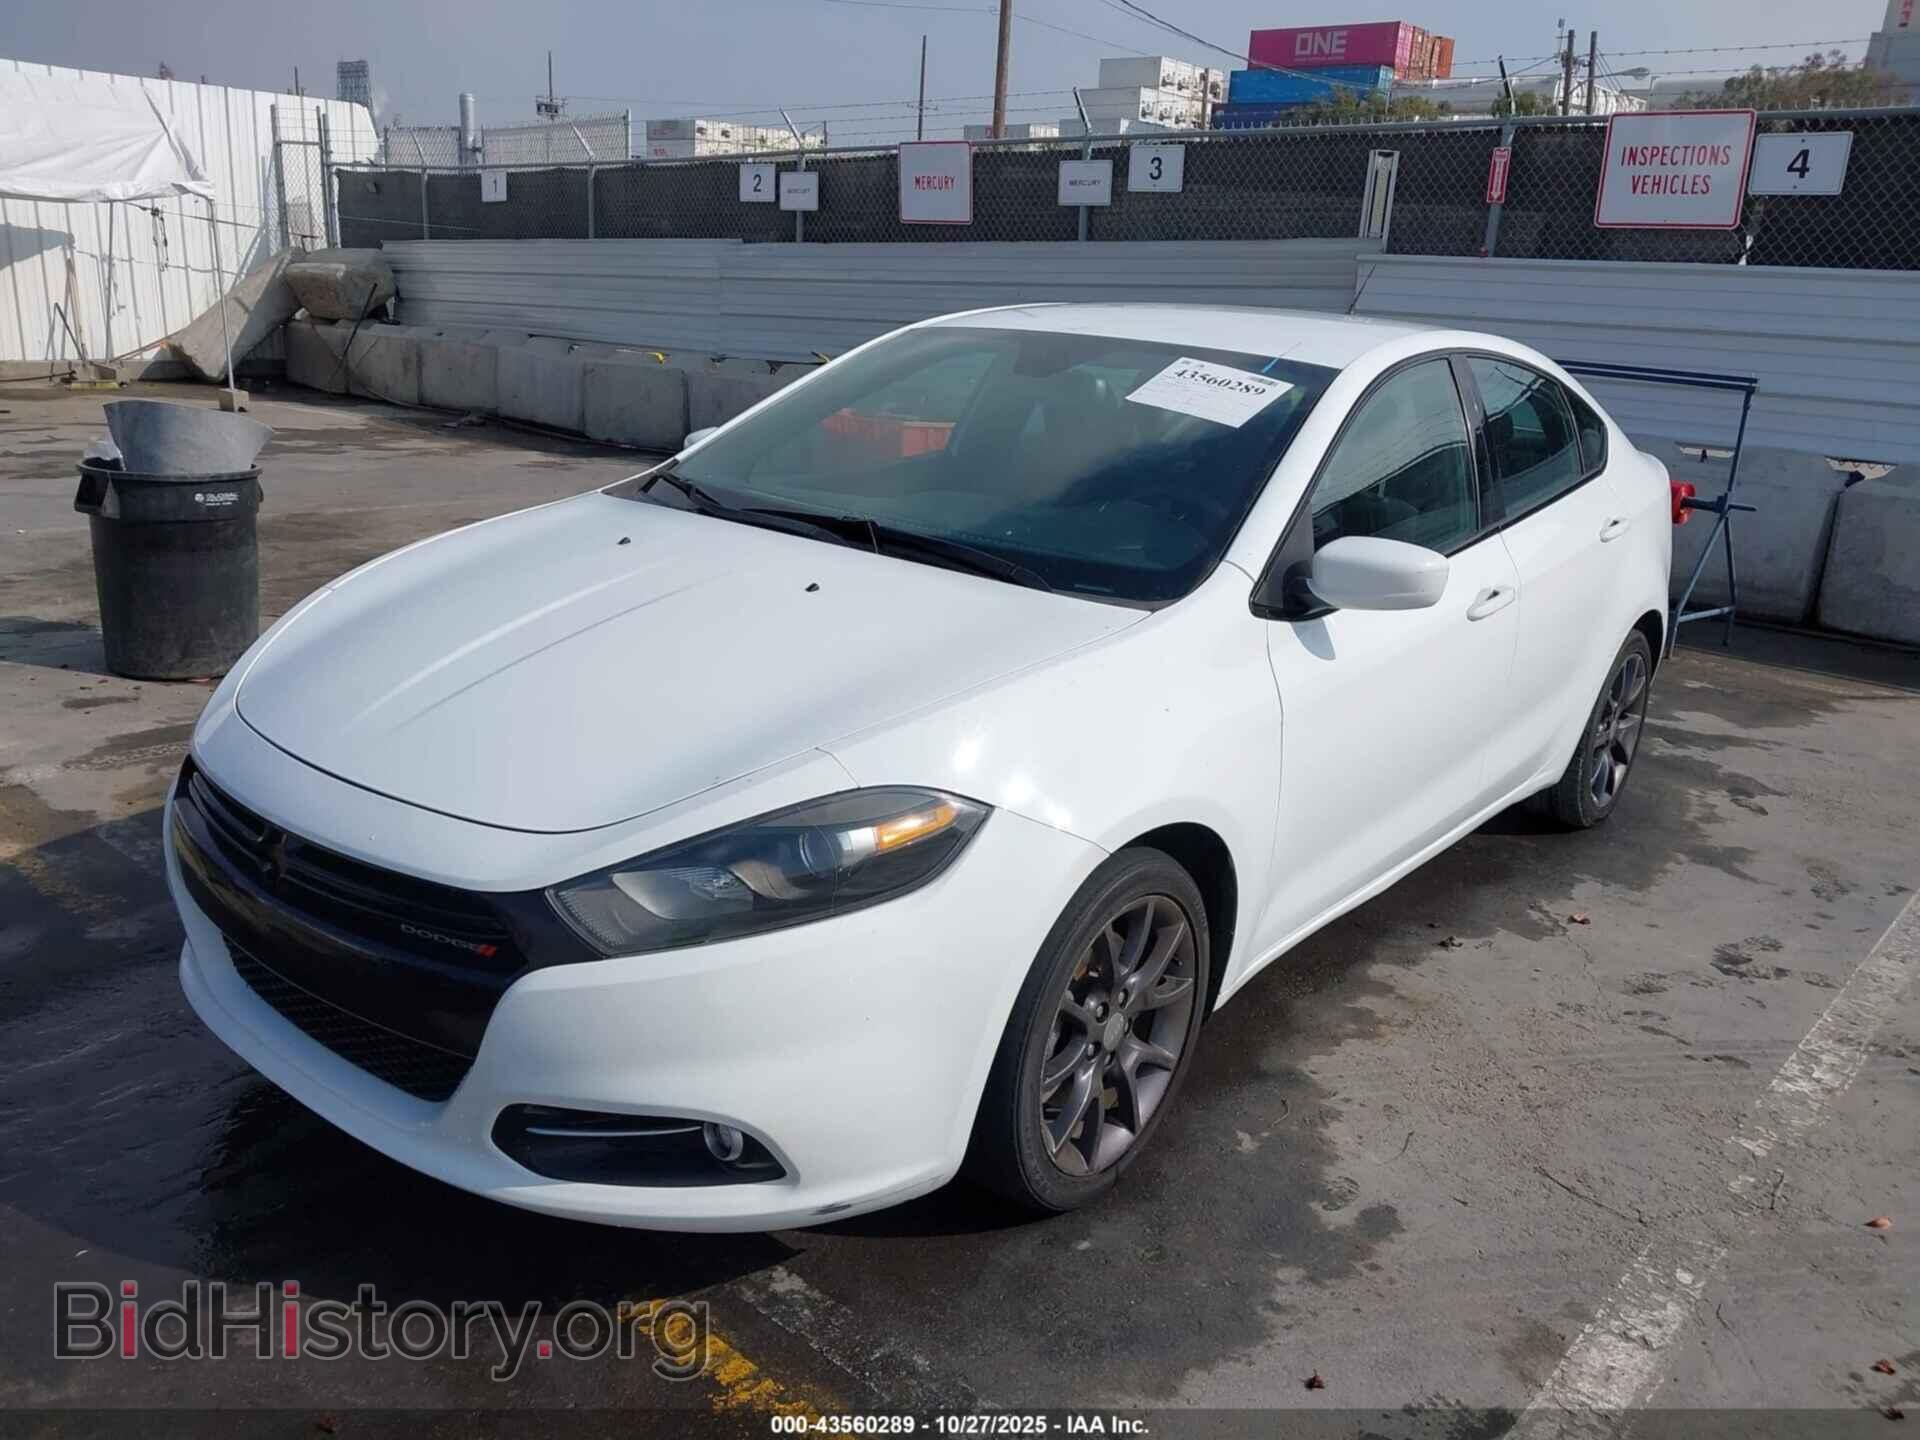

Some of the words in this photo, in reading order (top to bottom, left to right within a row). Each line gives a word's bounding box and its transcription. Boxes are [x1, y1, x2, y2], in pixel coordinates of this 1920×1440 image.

[1295, 31, 1347, 55] ONE
[1621, 145, 1731, 167] INSPECTIONS
[1786, 149, 1810, 179] 4
[1149, 156, 1163, 180] 3
[752, 174, 762, 193] 2
[914, 175, 955, 191] MERCURY
[1631, 174, 1711, 195] VEHICLES
[1174, 368, 1267, 396] 43560289
